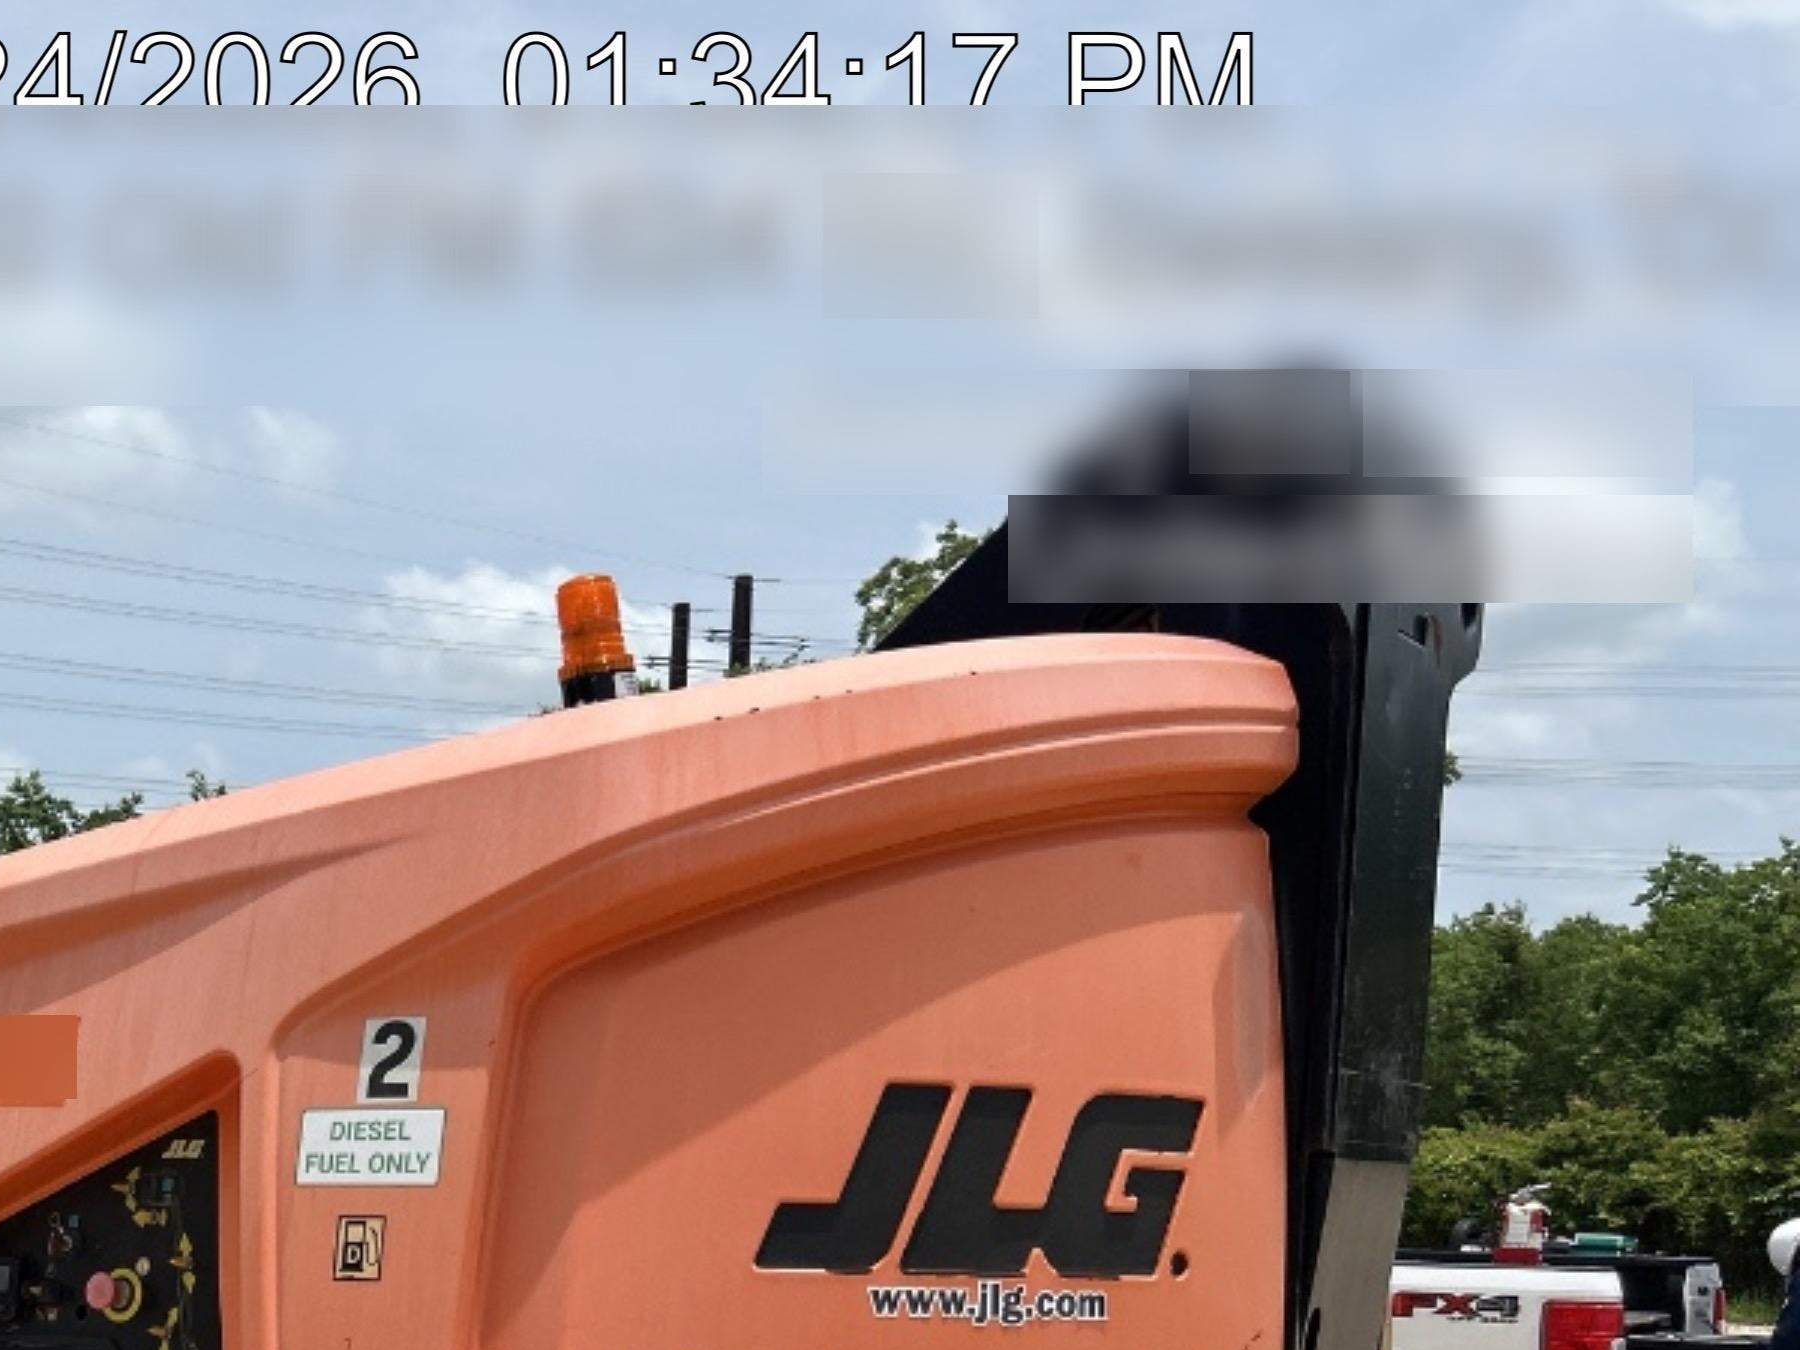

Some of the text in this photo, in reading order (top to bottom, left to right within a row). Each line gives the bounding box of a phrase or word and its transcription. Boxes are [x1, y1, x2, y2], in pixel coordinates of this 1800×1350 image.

[366, 1019, 417, 1099] 2
[329, 1120, 412, 1142] DIESEL
[304, 1152, 432, 1175] FUEL ONLY
[753, 1082, 1206, 1280] JLG
[869, 1282, 1107, 1324] www.jlg.com
[1391, 1292, 1520, 1318] FX4
